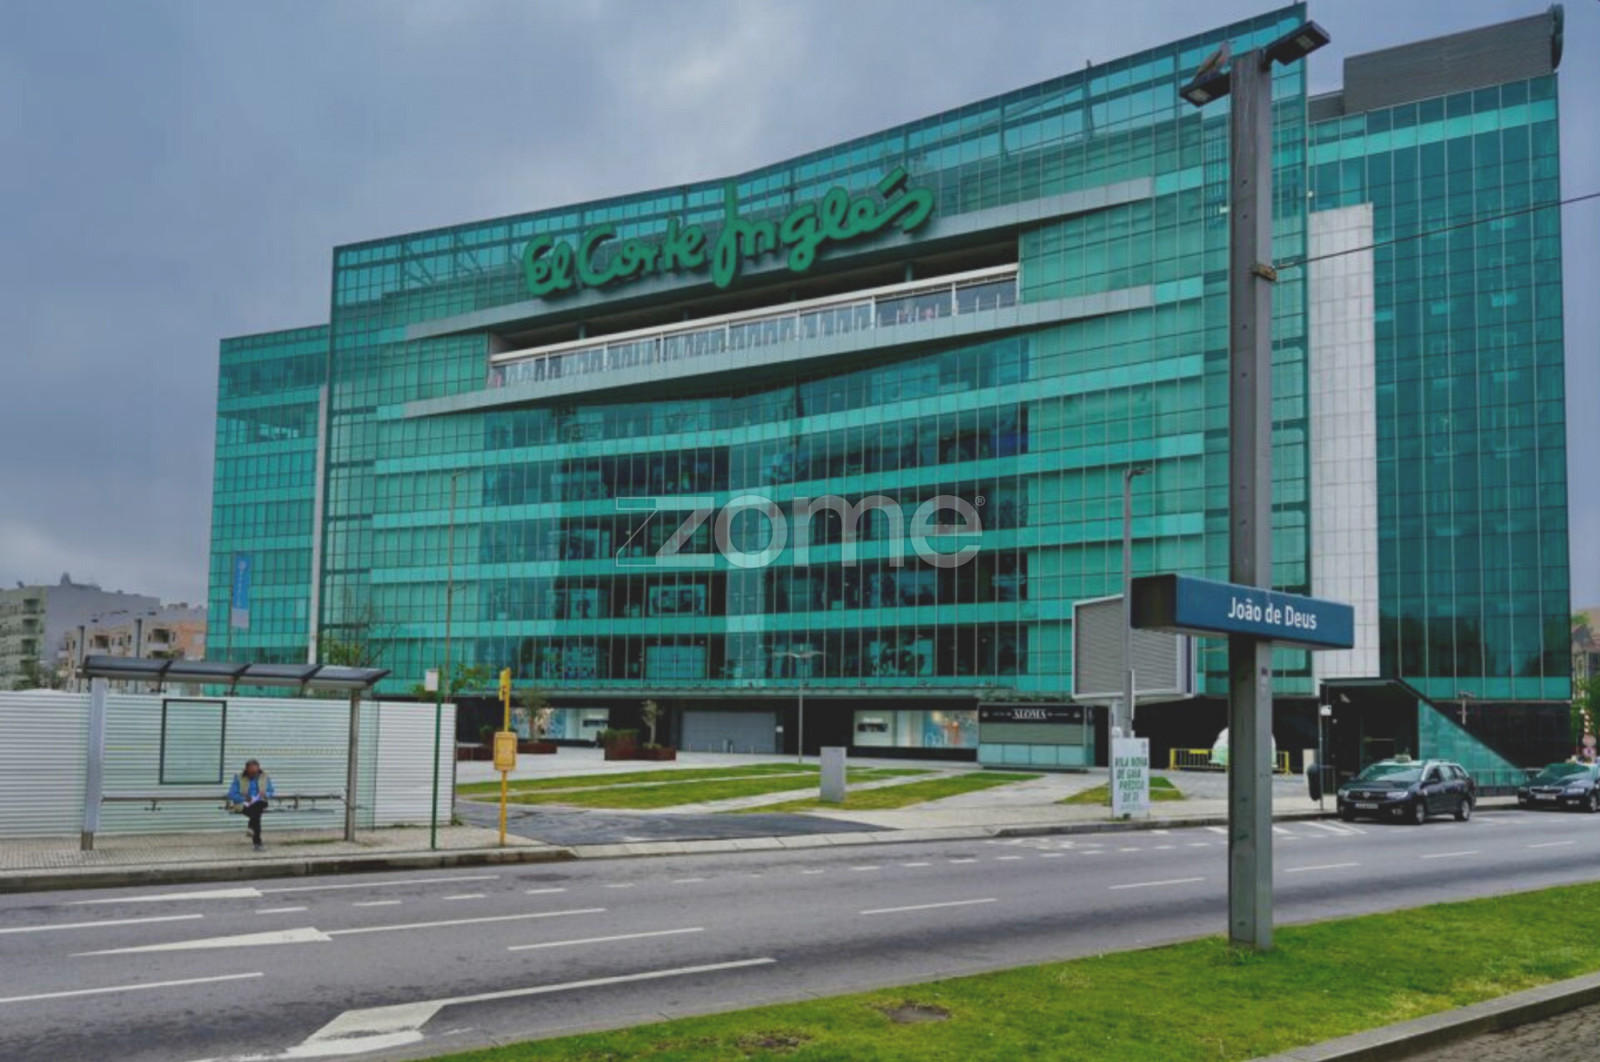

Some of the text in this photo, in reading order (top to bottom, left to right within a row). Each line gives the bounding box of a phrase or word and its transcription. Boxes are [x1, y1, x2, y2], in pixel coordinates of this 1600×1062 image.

[523, 235, 573, 296] El
[576, 215, 705, 287] Corte
[1228, 597, 1317, 630] João de Deus
